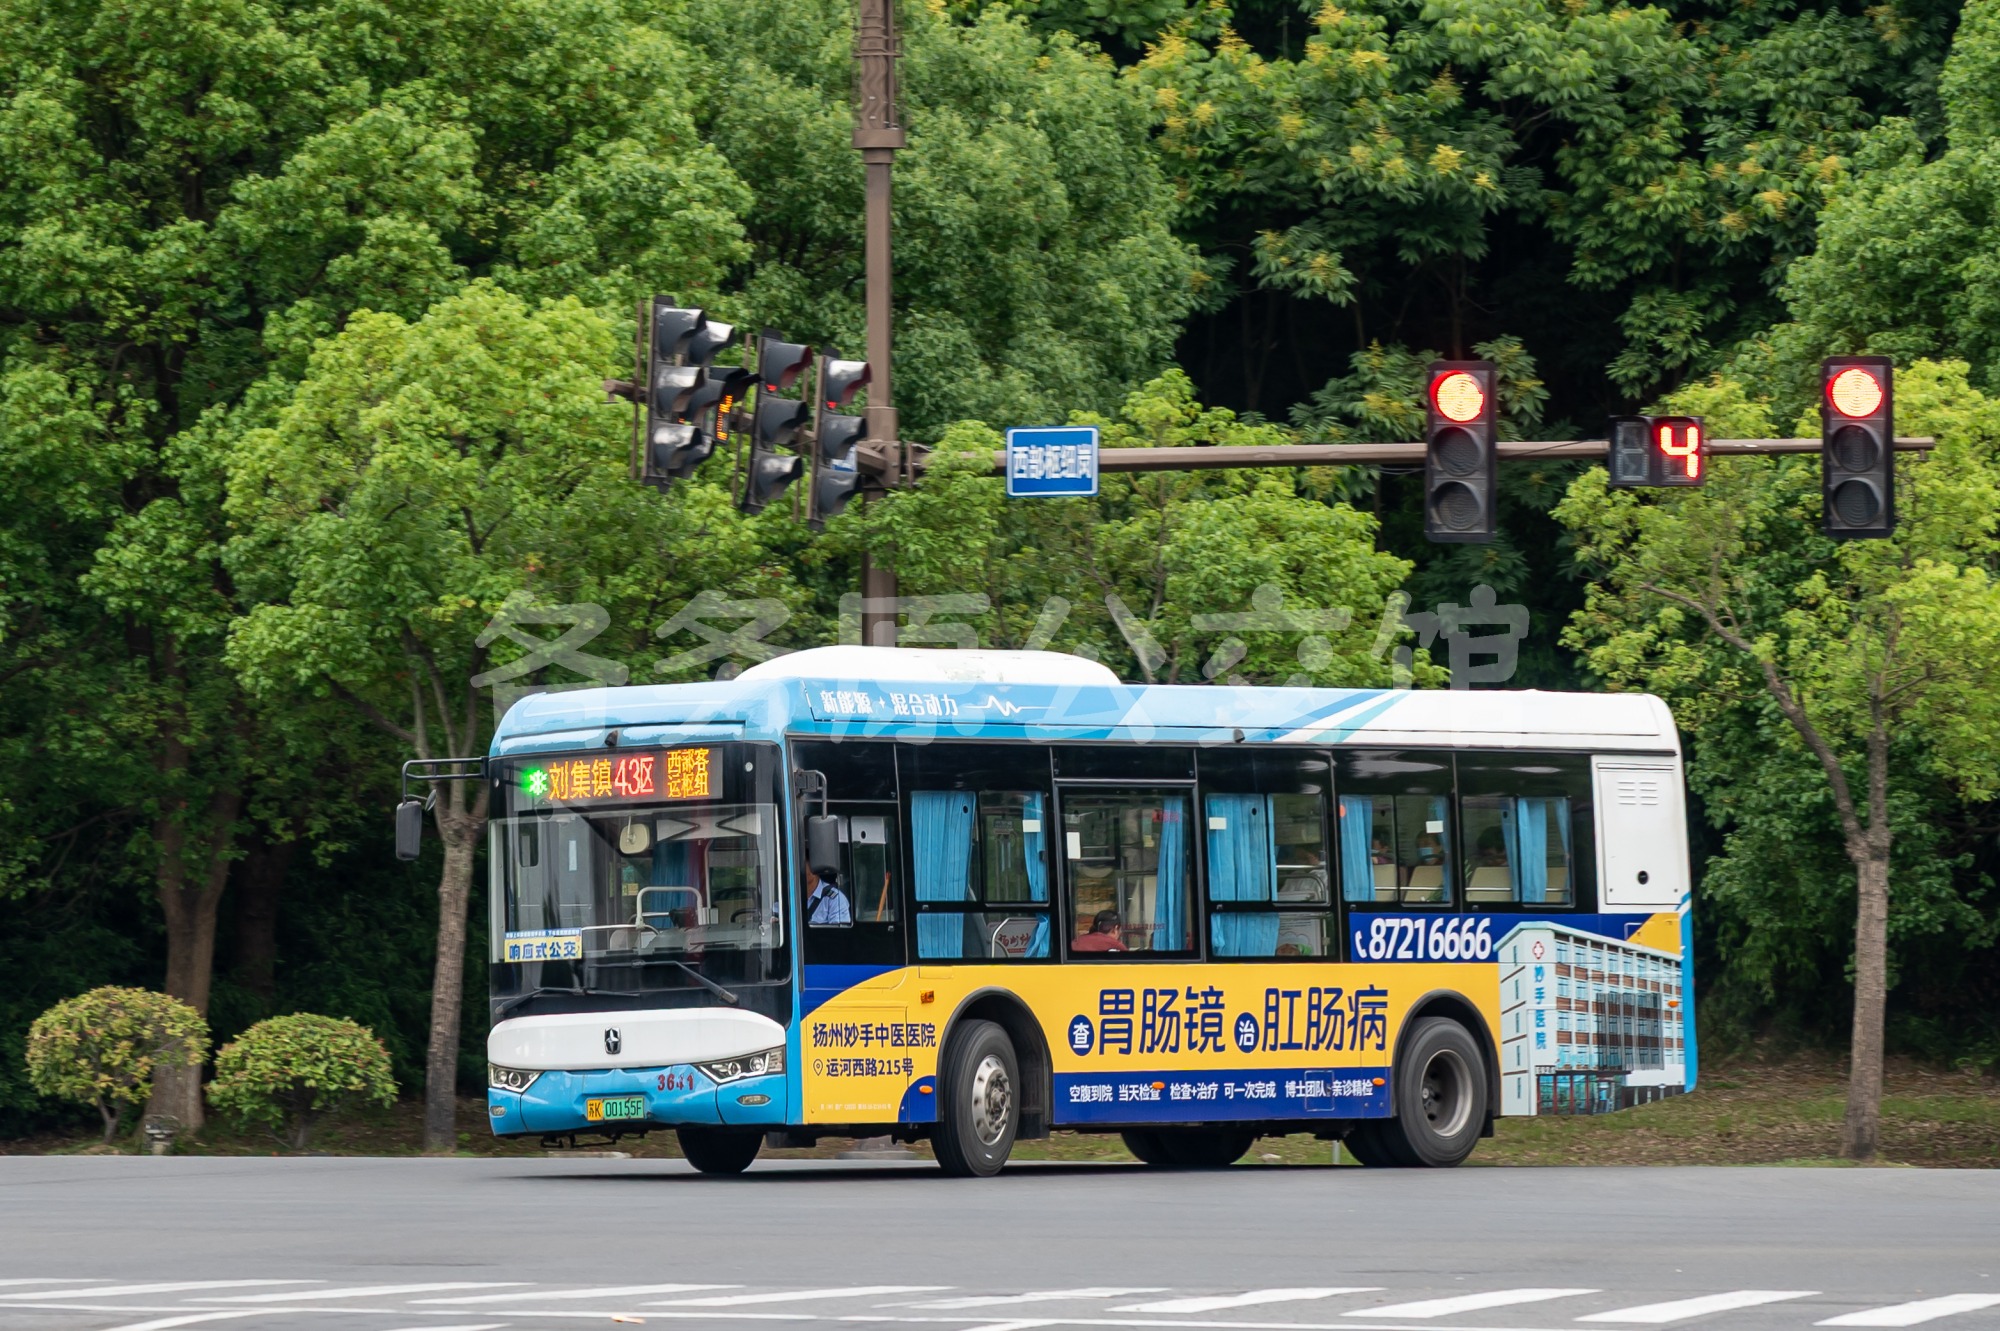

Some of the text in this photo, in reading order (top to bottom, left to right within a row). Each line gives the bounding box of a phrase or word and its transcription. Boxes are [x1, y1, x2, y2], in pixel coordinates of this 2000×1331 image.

[1660, 425, 1699, 478] 4
[820, 690, 959, 716] 新能源 混合动力
[549, 756, 654, 800] 刘集镇 43区
[509, 941, 576, 960] 响应式公交
[1369, 917, 1491, 960] 87216666
[1072, 984, 1389, 1056] 查 胃肠镜 治 肛肠病
[1534, 964, 1546, 1050] 妙手医院
[813, 1022, 937, 1048] 扬州妙手中医医院
[826, 1058, 914, 1077] 运河西路215号
[1069, 1079, 1374, 1103] 空腹到院 当天检查 检查+治疗 可一次完成 博士团队 亲诊精检
[605, 1100, 642, 1118] 00155F
